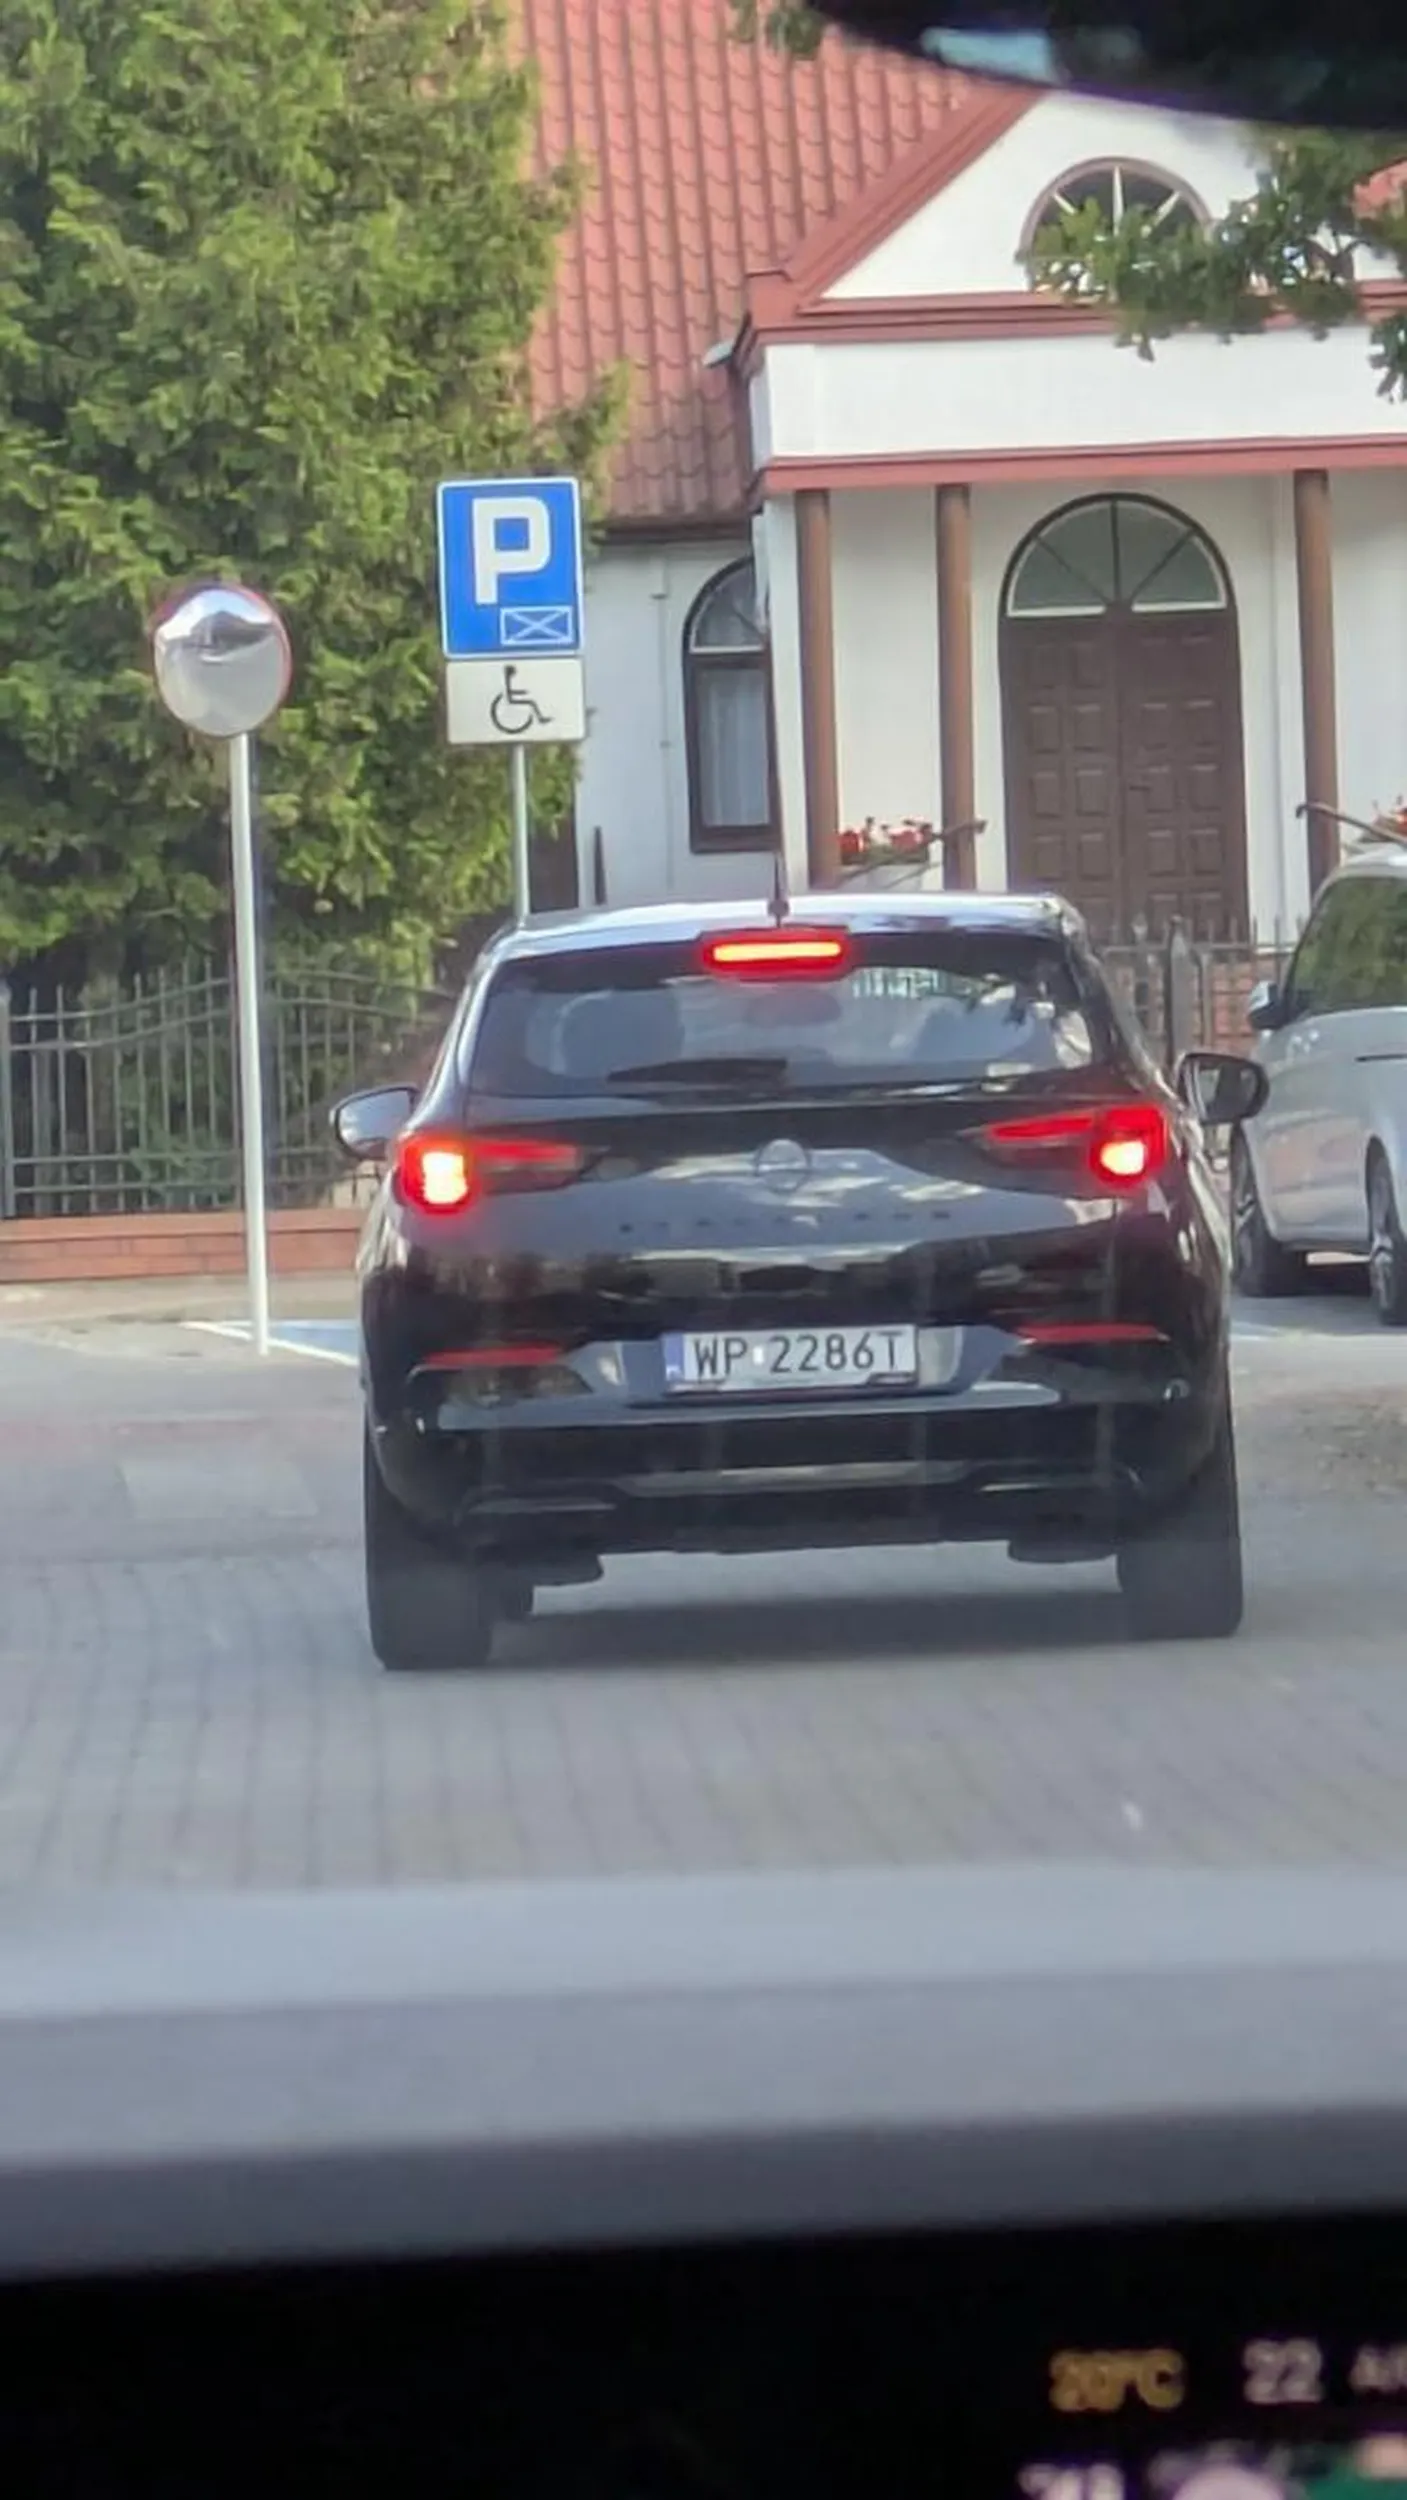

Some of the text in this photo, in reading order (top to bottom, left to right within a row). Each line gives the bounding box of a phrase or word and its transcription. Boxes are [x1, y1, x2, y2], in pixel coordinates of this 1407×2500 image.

[472, 497, 550, 604] P
[694, 1336, 748, 1376] WP
[769, 1331, 904, 1374] 2286T
